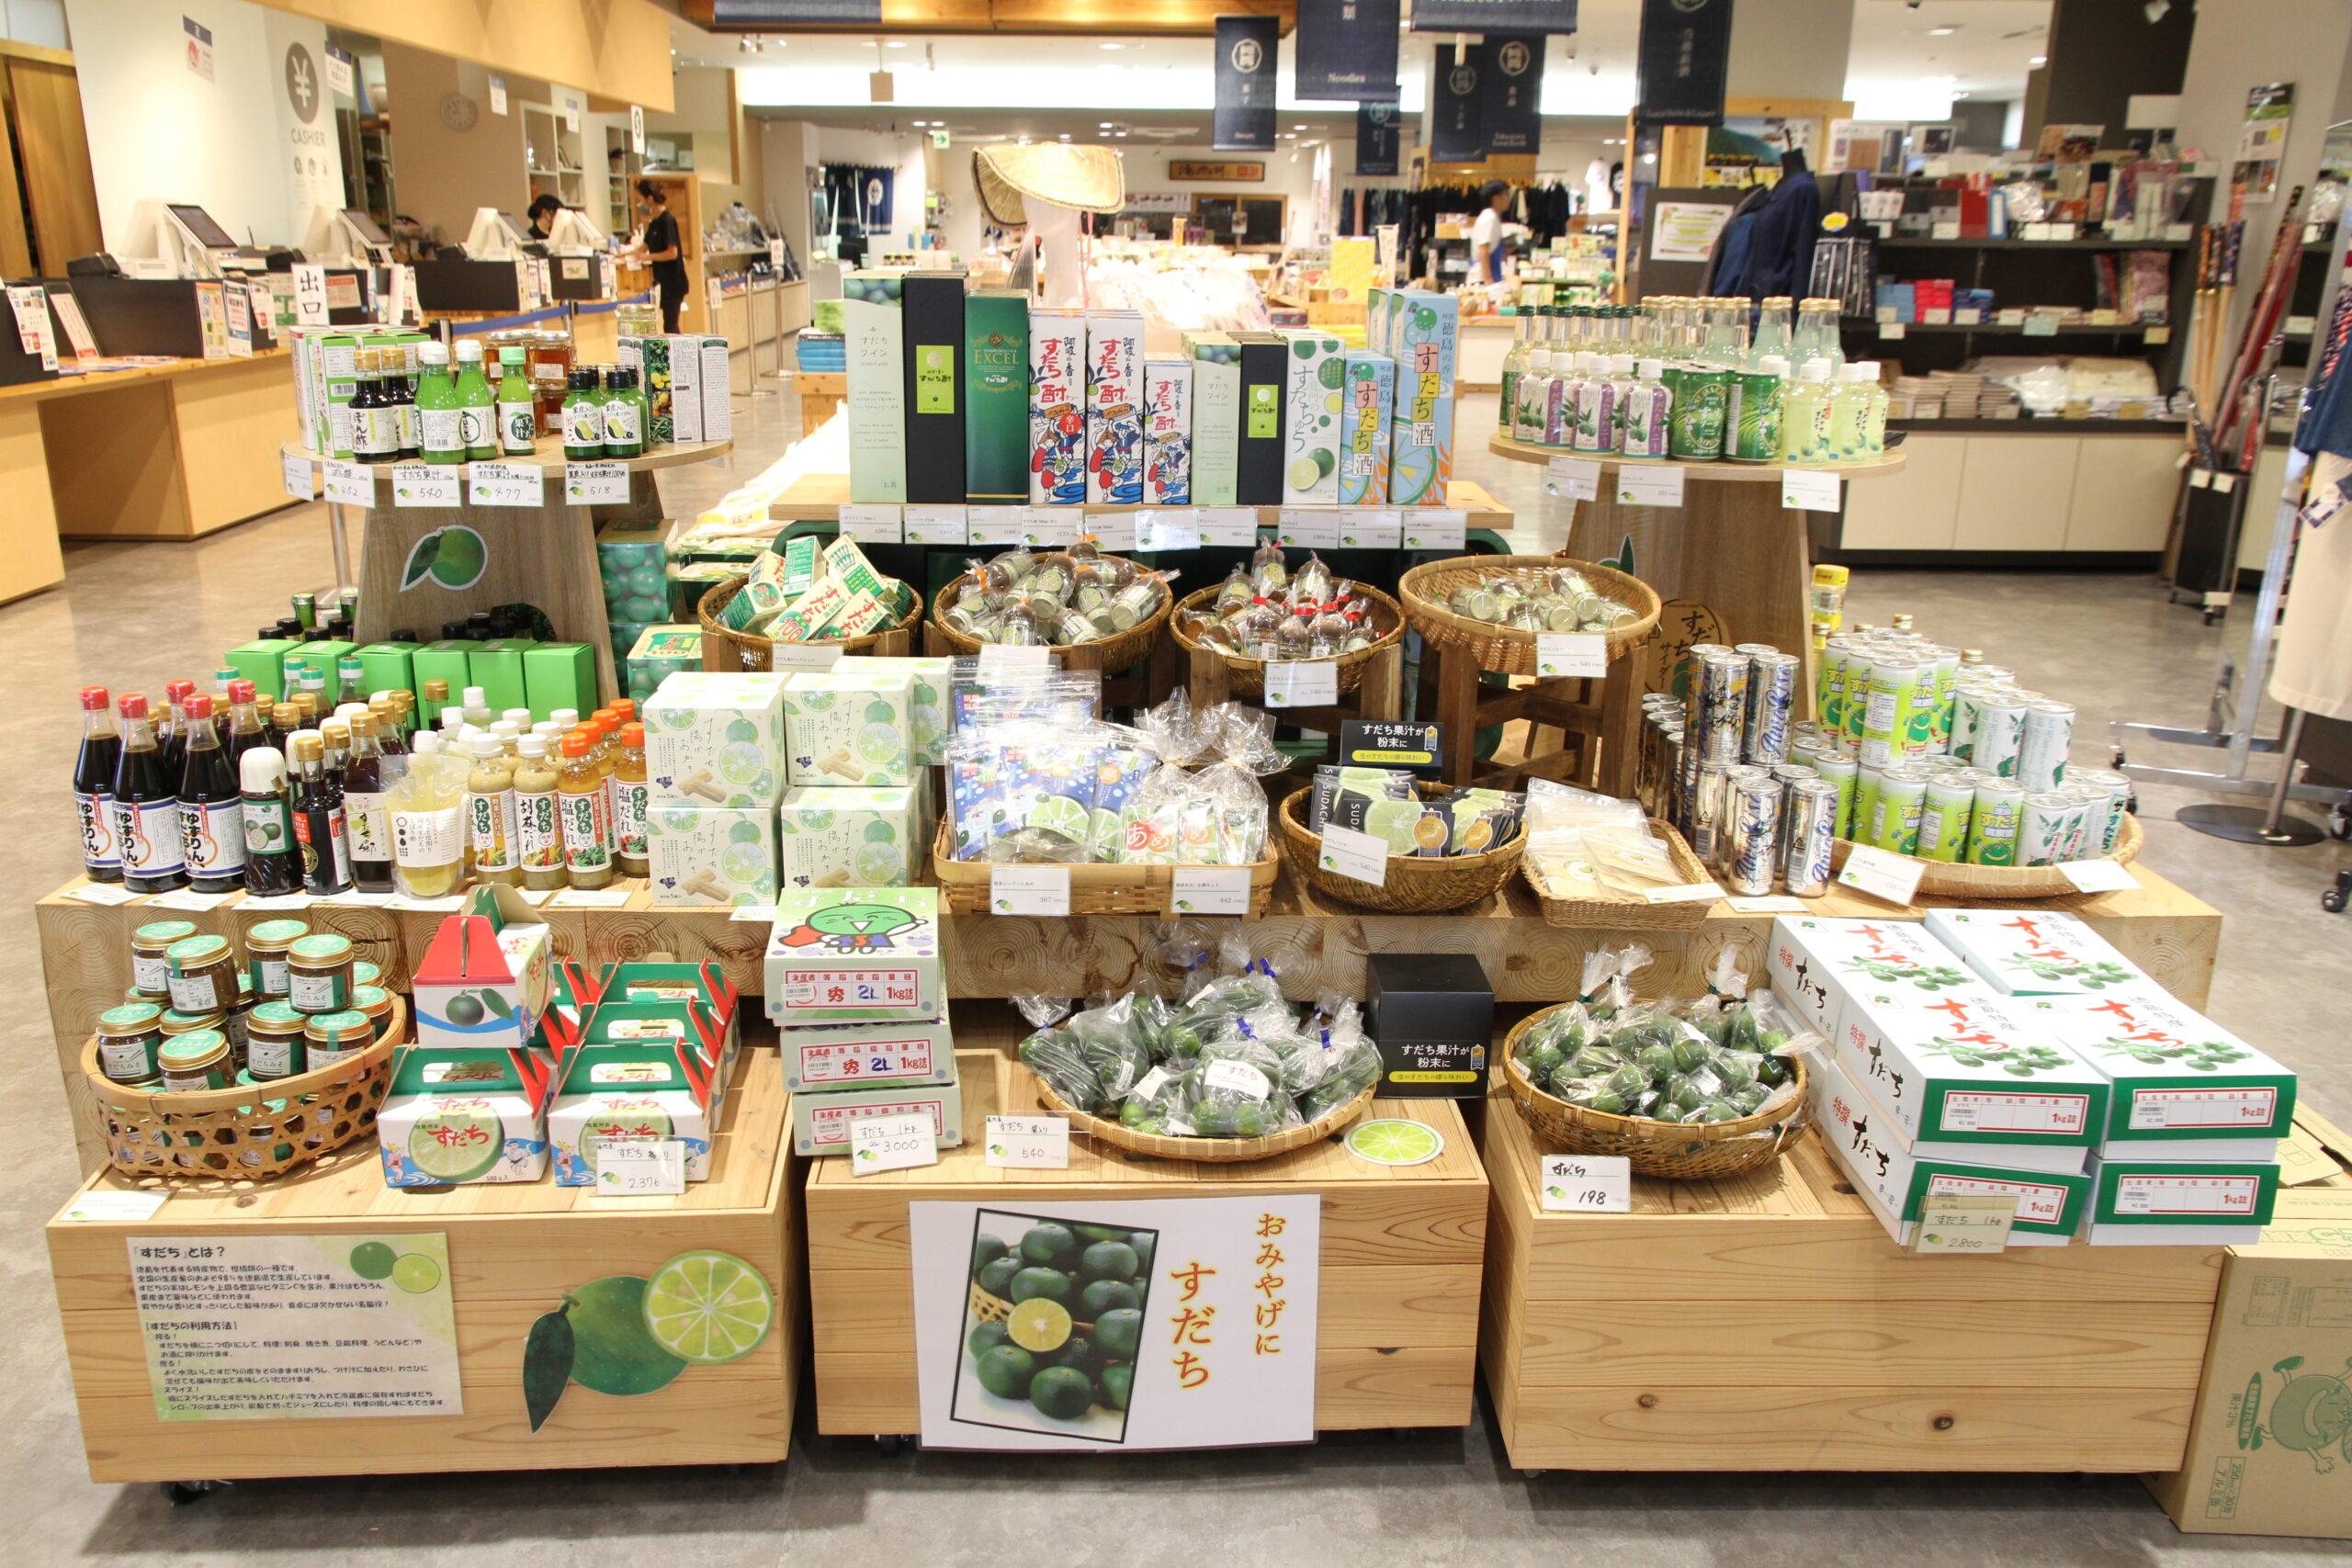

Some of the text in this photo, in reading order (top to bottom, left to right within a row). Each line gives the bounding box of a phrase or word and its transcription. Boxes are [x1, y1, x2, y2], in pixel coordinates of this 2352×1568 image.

[1328, 73, 1366, 85] Noodles
[290, 128, 327, 147] CASHIER
[300, 270, 322, 314] 出口
[860, 336, 888, 345] すだち
[860, 348, 888, 358] ワイン
[974, 348, 1020, 365] EXCEL
[1413, 344, 1440, 446] すだち酒
[353, 412, 368, 448] ぽん酢
[514, 416, 525, 439] 果汁
[1065, 415, 1076, 433] 辛口
[1353, 382, 1378, 477] すだち酒
[400, 469, 441, 480] すだち果汁
[419, 487, 442, 499] 540
[494, 486, 521, 501] 477
[590, 486, 611, 495] 518
[800, 584, 842, 624] すだち
[841, 597, 876, 638] すだち
[780, 615, 805, 640] 100
[1675, 612, 1715, 661] すだち
[1658, 642, 1671, 689] サイダー
[1363, 723, 1424, 737] すだち果汁が
[1377, 737, 1408, 749] 粉末に
[618, 785, 632, 833] 塩だれ
[634, 787, 647, 821] すだち
[475, 799, 489, 833] すだち
[492, 797, 503, 838] 野菜にかける
[520, 798, 537, 852] 胡麻だれ
[537, 799, 551, 833] すだち
[561, 797, 576, 847] 塩だれ
[576, 799, 590, 833] すだち
[1128, 820, 1172, 853] あめ
[1846, 922, 1919, 970] すだち
[1997, 916, 2081, 965] すだち
[1795, 957, 1826, 1010] すだち
[827, 985, 913, 1002] 秀 2L 1kg詰
[1923, 997, 2010, 1051] すだち
[2086, 998, 2184, 1048] すだち
[1401, 1043, 1470, 1057] すだち果汁が
[842, 1056, 927, 1075] 秀 2L 1kg詰
[1417, 1056, 1452, 1068] 粉末に
[1868, 1038, 1905, 1100] すだち
[1228, 1066, 1258, 1080] すだち
[432, 1097, 490, 1111] すだち
[602, 1098, 660, 1111] すだち
[2241, 1106, 2266, 1118] 1kg詰
[1000, 1120, 1023, 1132] すだち
[2052, 1112, 2077, 1124] 1kg詰
[426, 1123, 489, 1147] すだち
[860, 1126, 885, 1137] すだち
[617, 1147, 642, 1158] すだち
[884, 1140, 919, 1153] 3.000
[1022, 1147, 1045, 1159] 540
[1852, 1114, 1891, 1179] すだち
[1551, 1162, 1587, 1179] すだち
[628, 1177, 660, 1189] 2.376
[1578, 1189, 1606, 1205] 198
[2223, 1193, 2248, 1205] 1kg詰
[2030, 1201, 2054, 1213] 1kg詰
[1935, 1214, 1969, 1226] すだち
[1948, 1237, 1983, 1249] 2.800
[1255, 1213, 1286, 1357] おみやげに
[1170, 1261, 1217, 1390] すだち
[2209, 1467, 2227, 1509] アルミ缶
